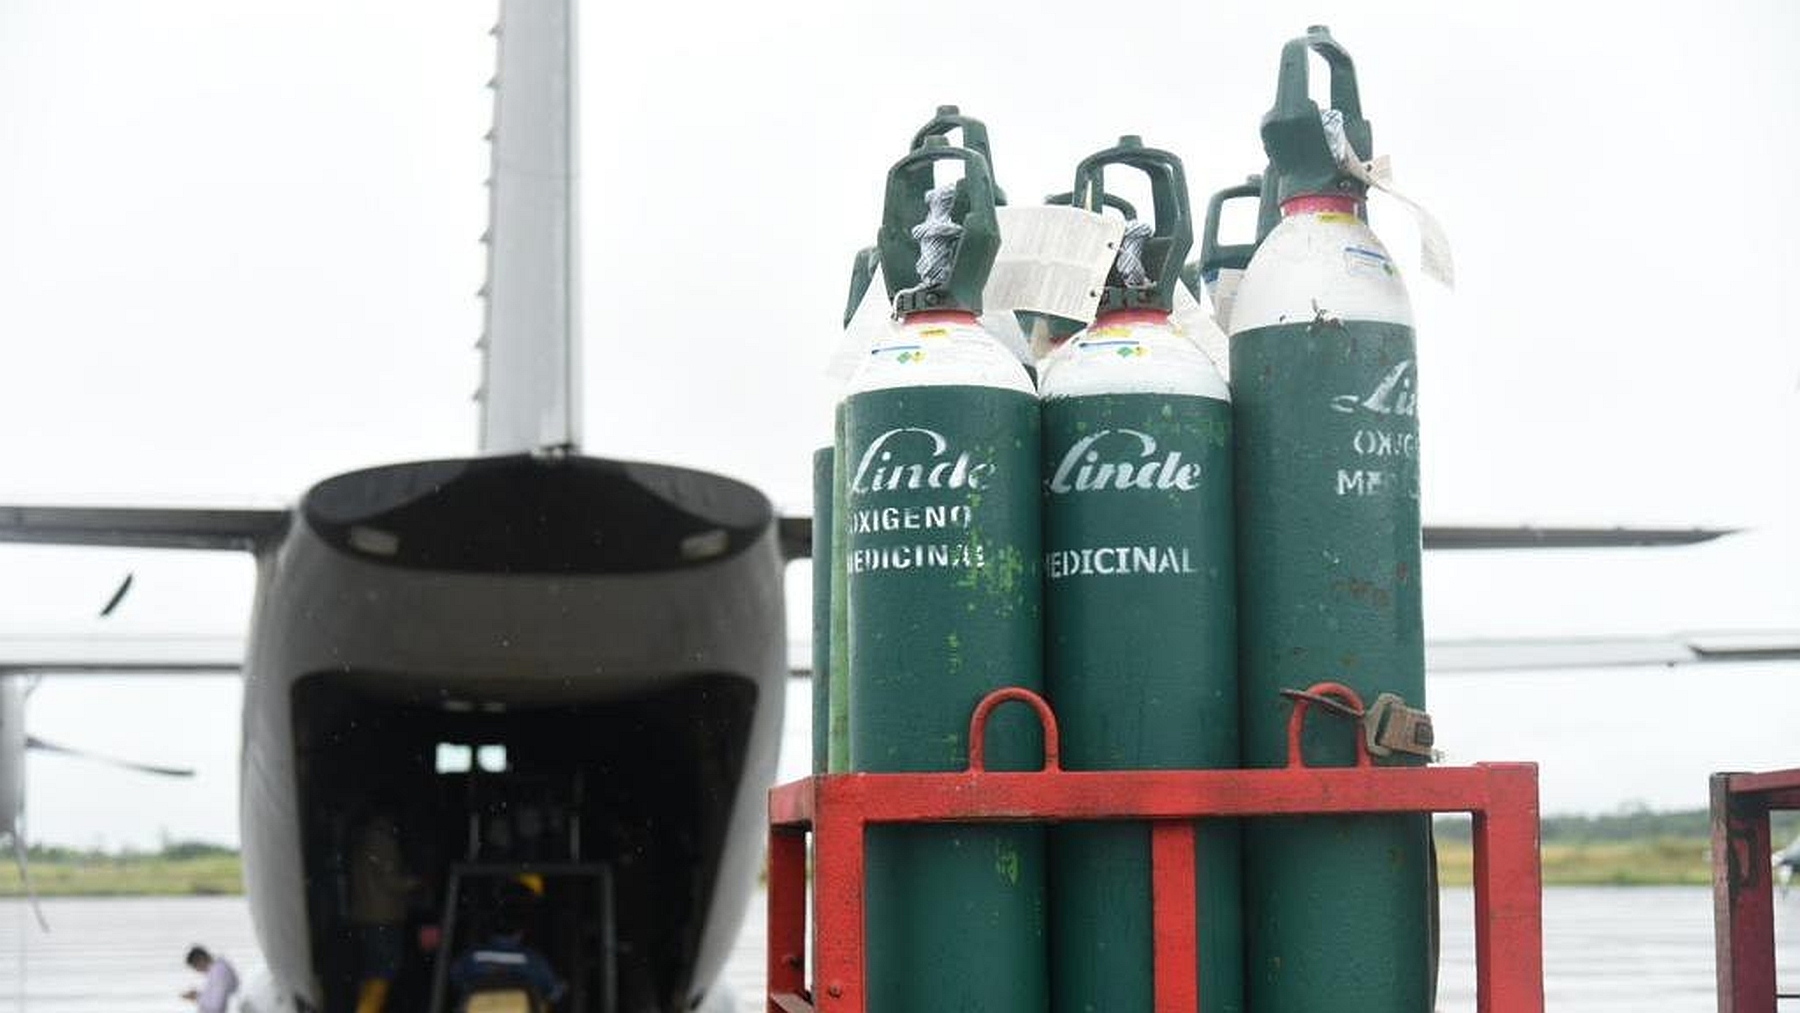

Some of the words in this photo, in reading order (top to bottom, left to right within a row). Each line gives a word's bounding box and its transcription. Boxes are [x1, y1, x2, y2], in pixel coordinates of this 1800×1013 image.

[852, 427, 997, 493] Linde
[1042, 428, 1202, 494] Linde
[1046, 547, 1197, 579] EDICINAL
